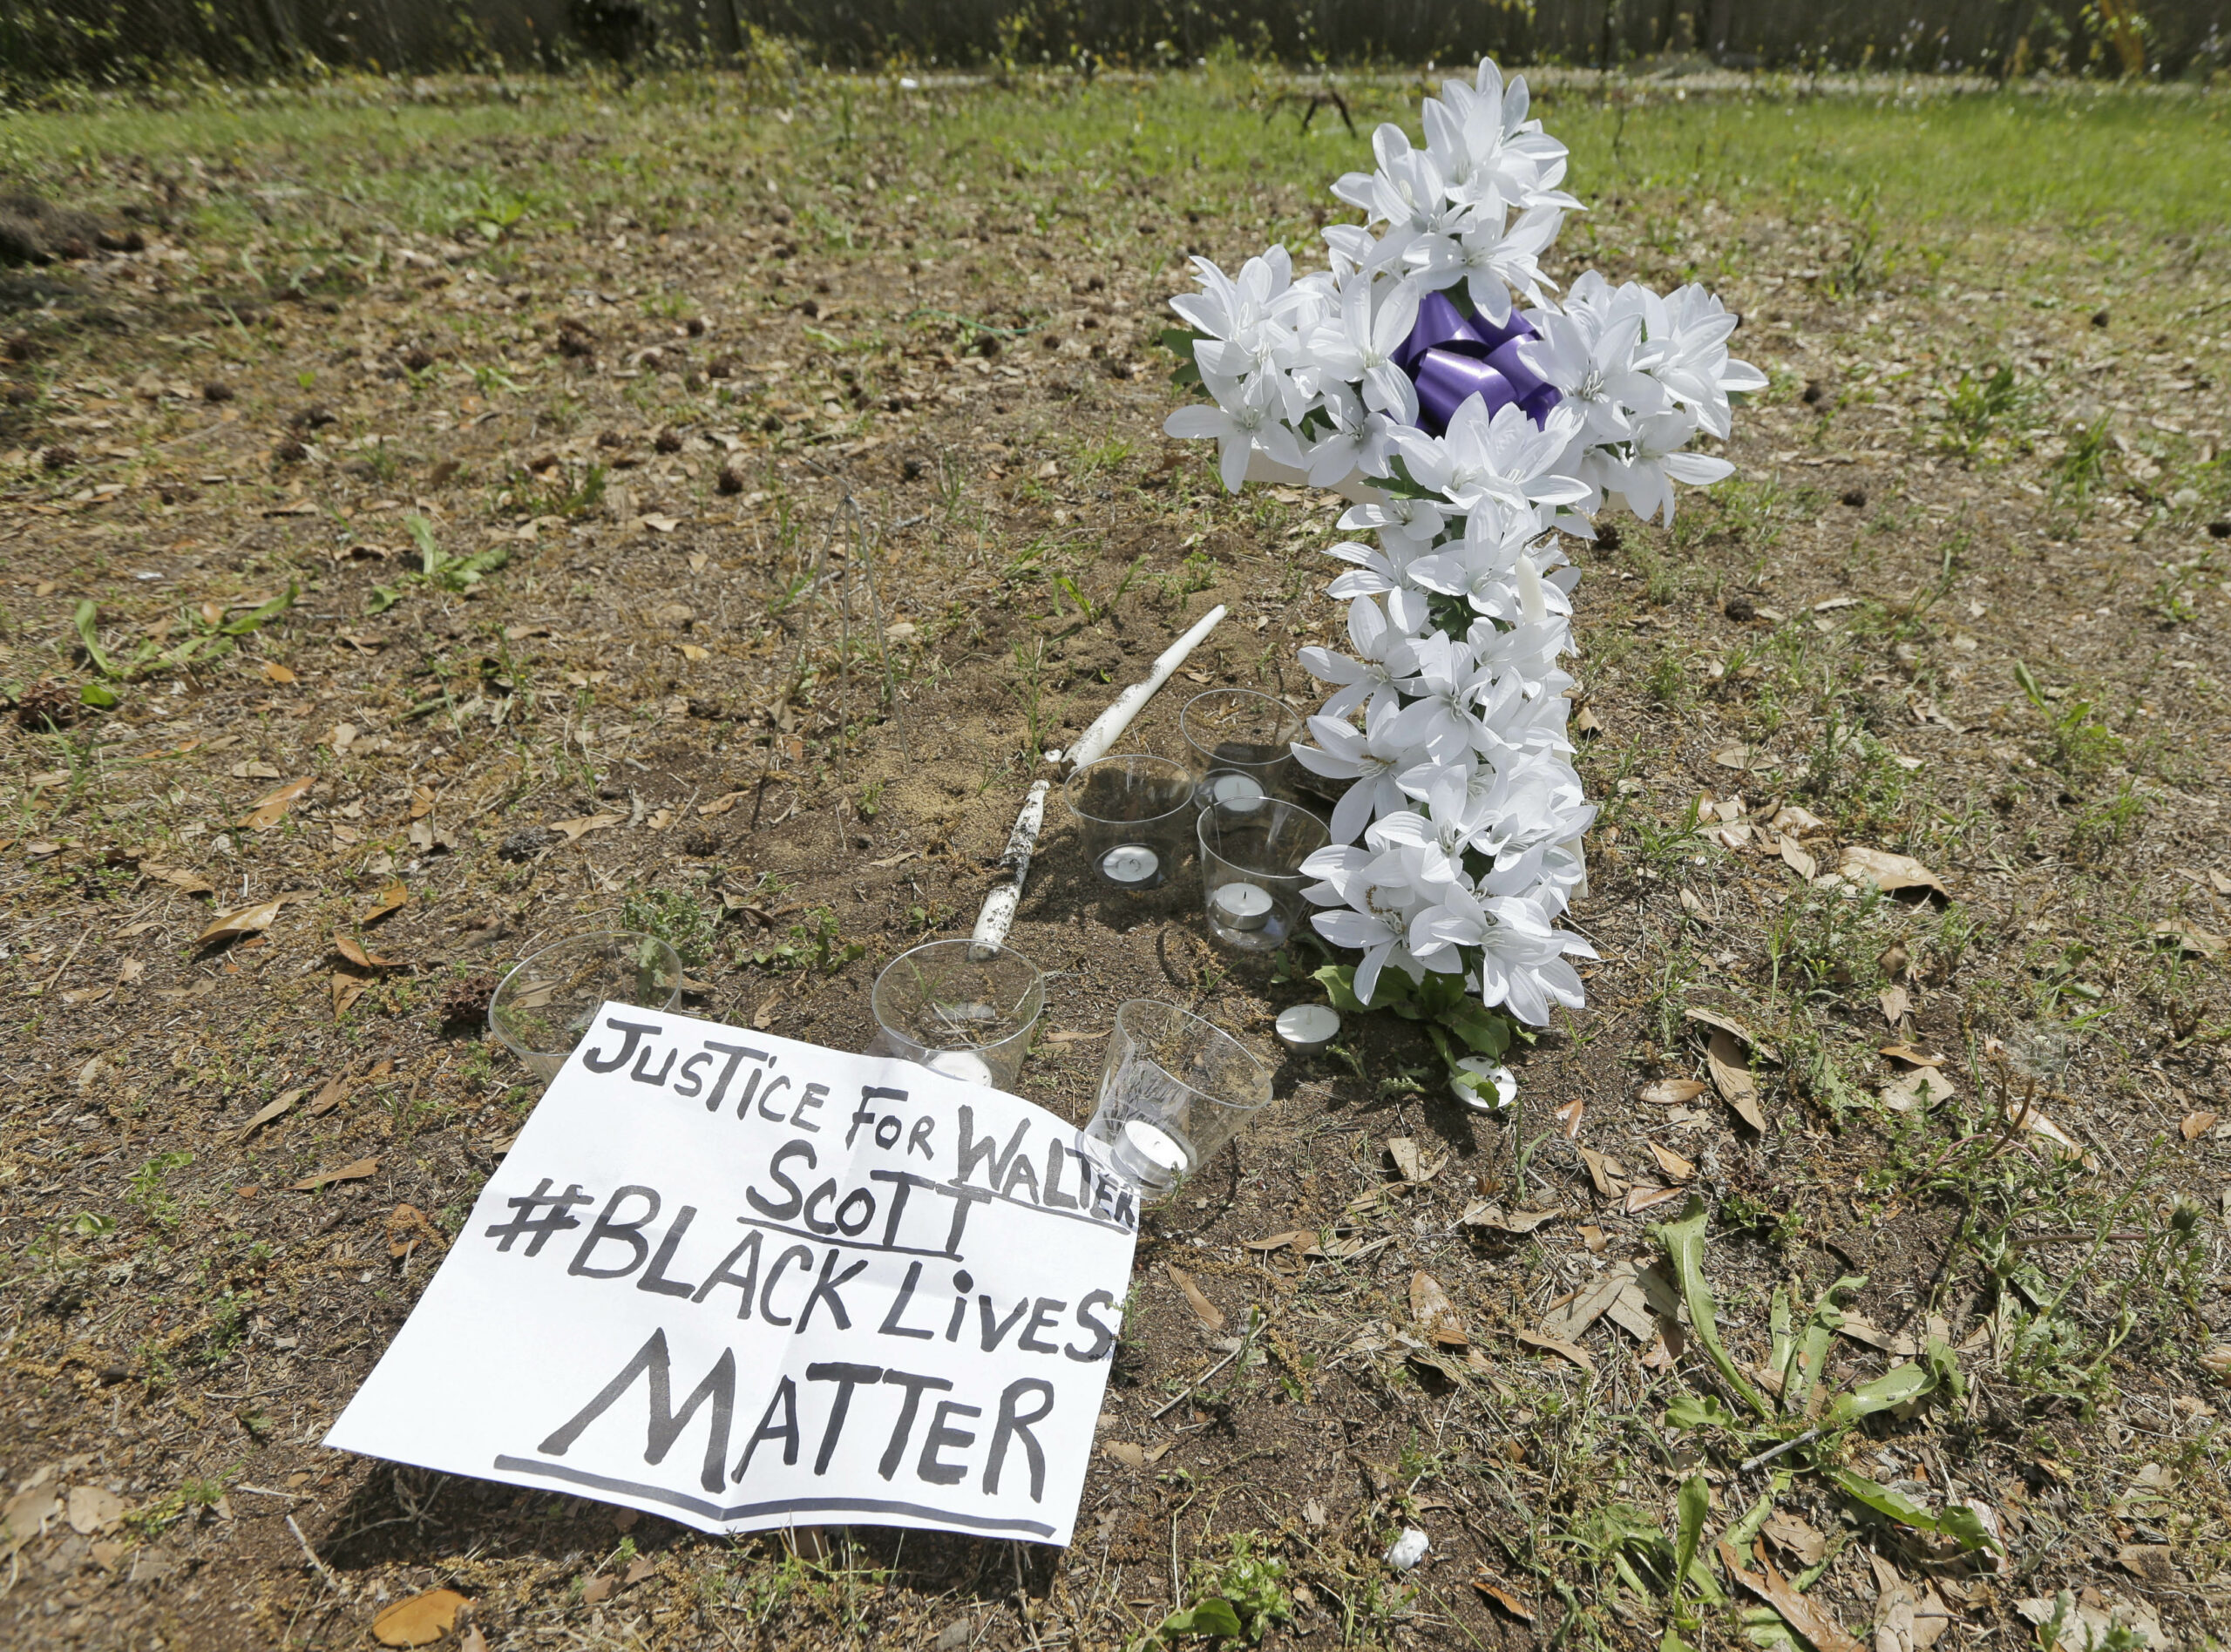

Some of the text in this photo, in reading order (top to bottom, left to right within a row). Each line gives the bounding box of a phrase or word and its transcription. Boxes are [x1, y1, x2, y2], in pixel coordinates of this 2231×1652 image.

[746, 1139, 993, 1256] SCOTT
[845, 1086, 935, 1161] FOR
[948, 1105, 1136, 1228] WALTER
[484, 1178, 869, 1334] #BLACK
[537, 1327, 1055, 1504] MATTER
